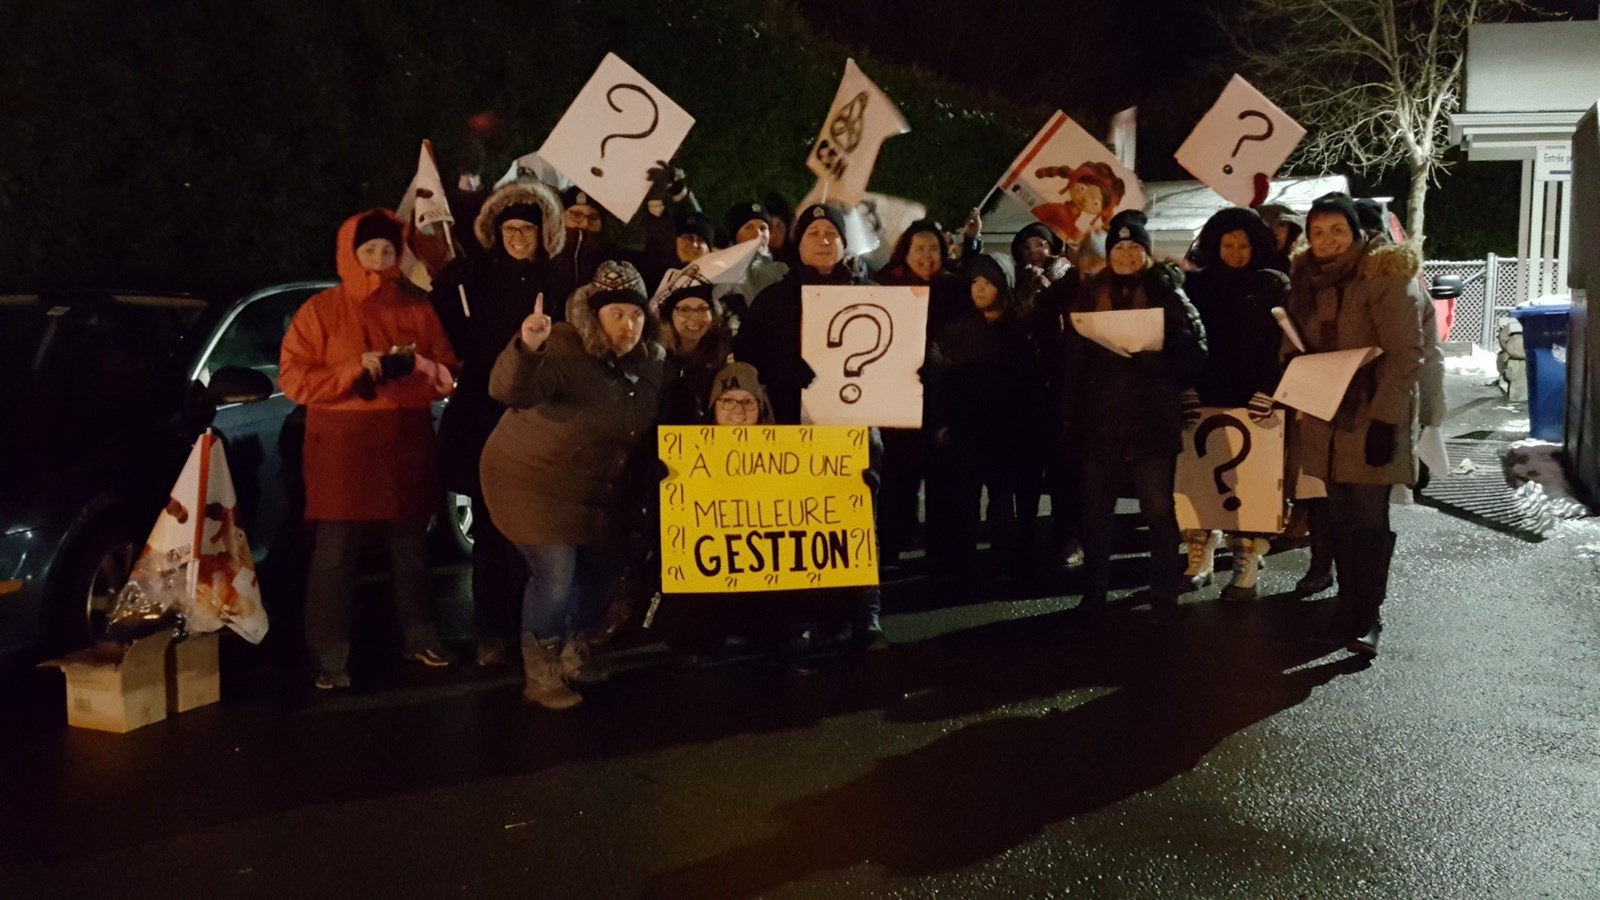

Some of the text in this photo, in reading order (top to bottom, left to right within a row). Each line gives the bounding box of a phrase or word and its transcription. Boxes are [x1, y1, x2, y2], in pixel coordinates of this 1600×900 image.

[590, 83, 659, 178] ?
[1223, 110, 1274, 175] ?
[1544, 152, 1564, 163] Entrée
[827, 303, 893, 404] ?
[689, 444, 852, 478] À QUAND UNE
[1194, 414, 1251, 511] ?
[694, 495, 841, 529] MEILLEURE
